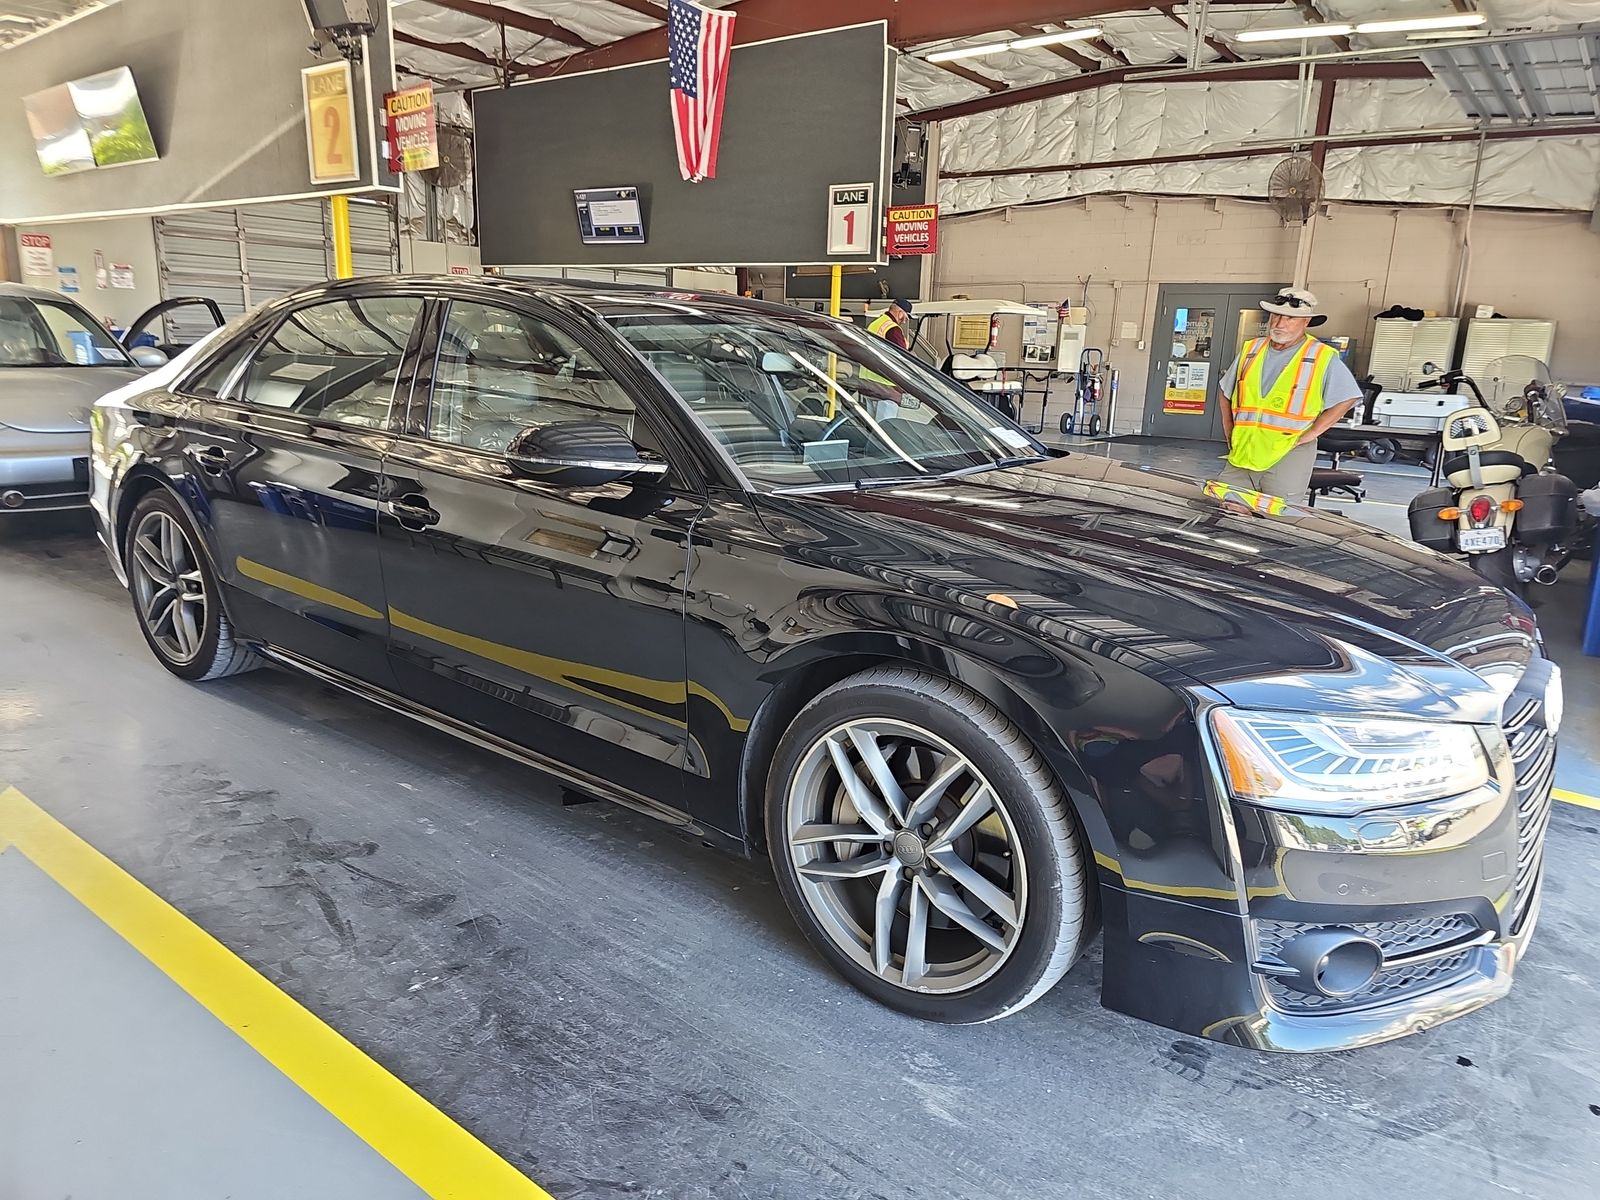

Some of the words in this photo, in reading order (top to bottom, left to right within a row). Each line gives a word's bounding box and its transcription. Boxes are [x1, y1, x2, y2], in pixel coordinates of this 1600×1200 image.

[312, 74, 344, 93] LANE
[390, 91, 428, 113] CAUTION
[395, 111, 427, 133] MOVING
[323, 106, 343, 164] 2
[395, 131, 430, 152] VEHICLES
[836, 190, 865, 203] LANE
[892, 209, 933, 221] CAUTION
[843, 210, 855, 245] 1
[895, 221, 929, 232] MOVING
[22, 234, 51, 247] STOP
[894, 232, 930, 243] VEHICLES
